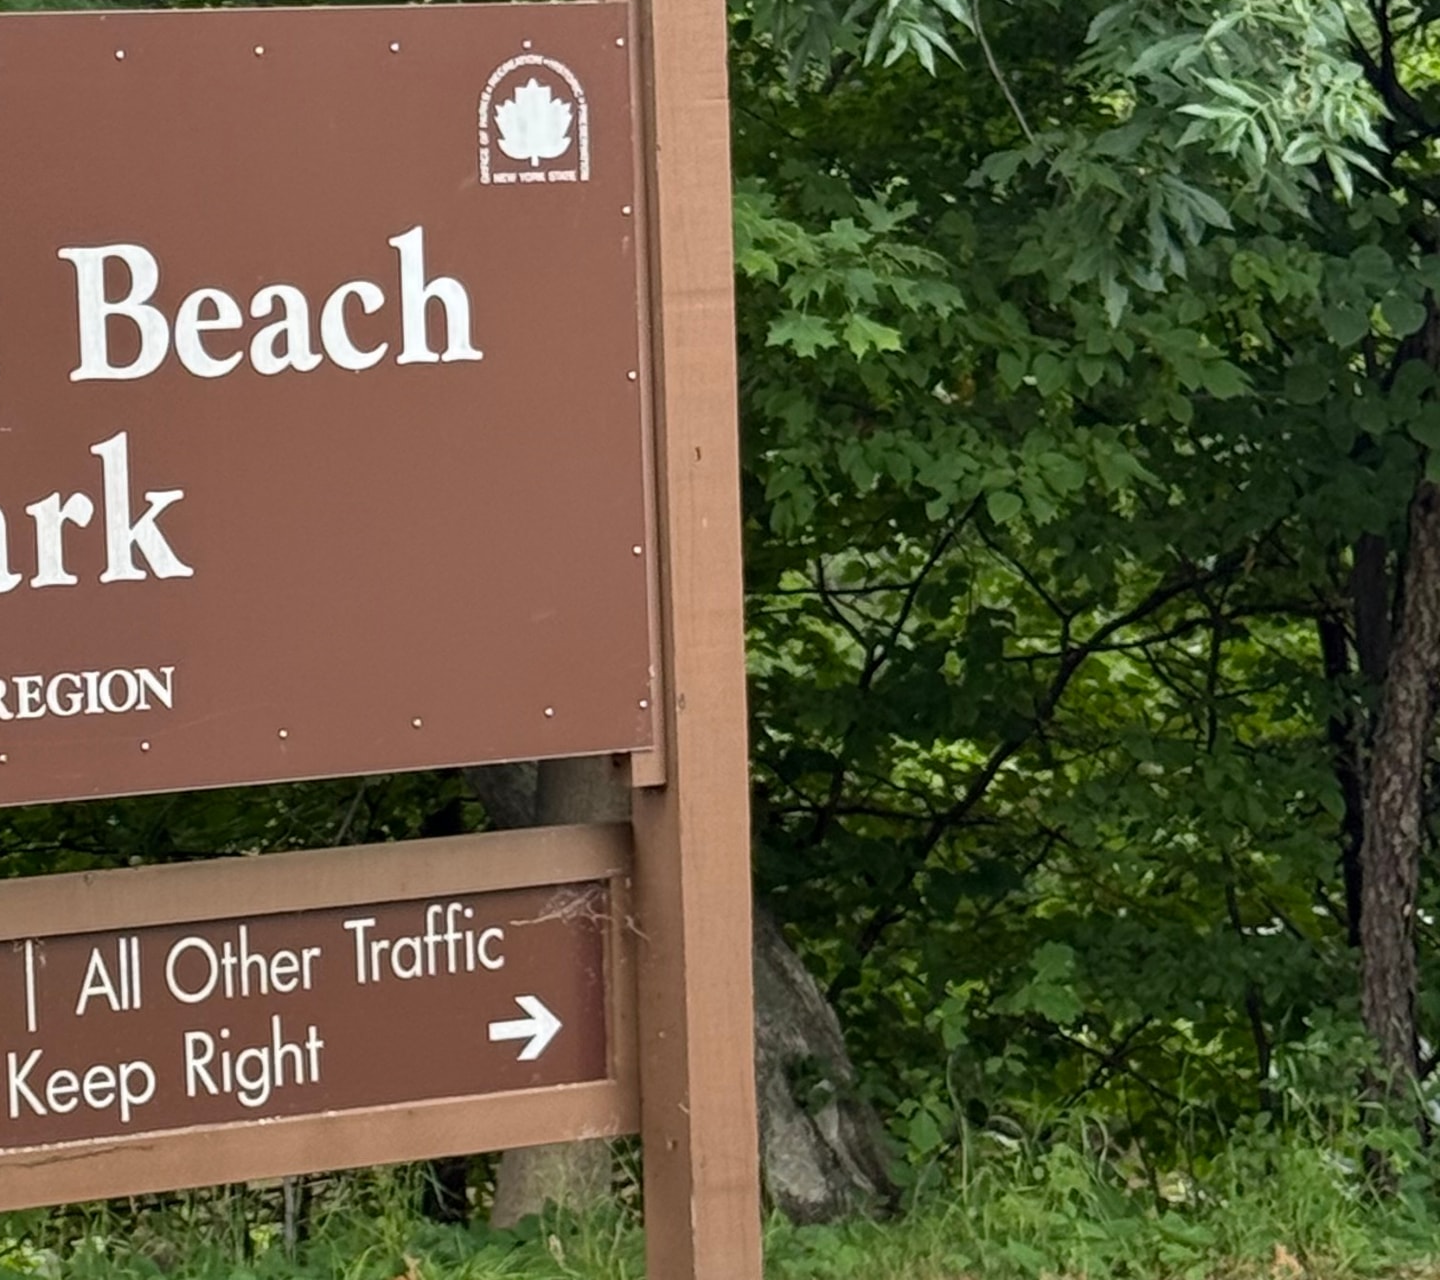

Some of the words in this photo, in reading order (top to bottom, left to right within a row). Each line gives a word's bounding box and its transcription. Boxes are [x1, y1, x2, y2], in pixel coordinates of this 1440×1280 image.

[56, 224, 485, 383] Beach
[74, 935, 142, 1016] All
[165, 924, 322, 1004] Other
[342, 901, 506, 985] Traffic
[6, 1048, 157, 1124] Keep
[183, 1013, 325, 1108] Right
